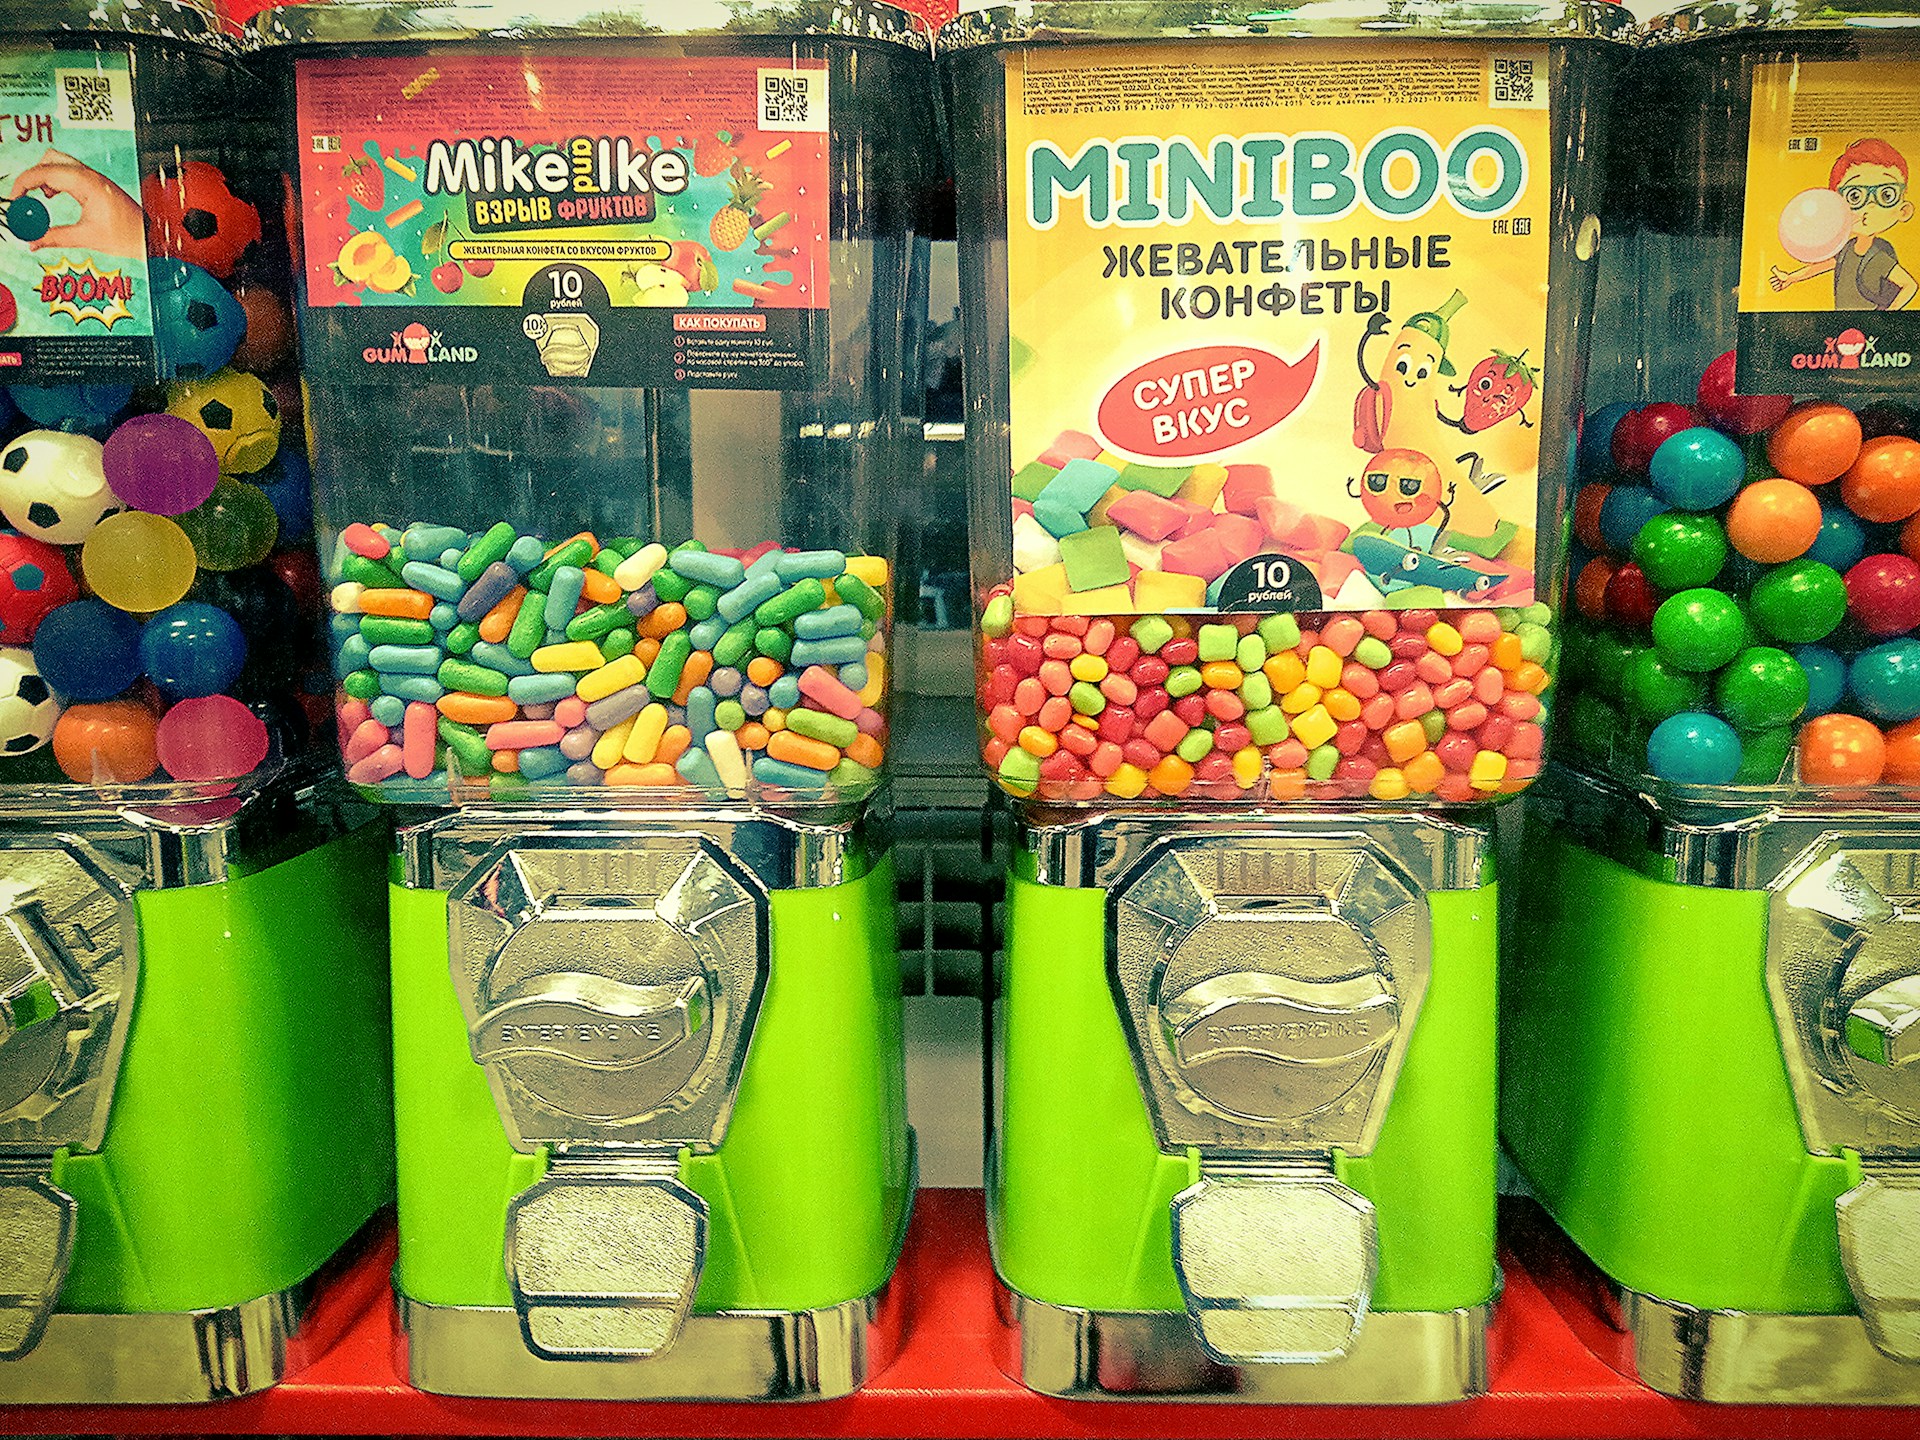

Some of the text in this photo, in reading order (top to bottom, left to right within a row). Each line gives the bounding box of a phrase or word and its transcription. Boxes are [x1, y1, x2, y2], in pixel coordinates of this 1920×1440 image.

[426, 138, 687, 193] Mike and Ike
[1030, 129, 1525, 225] MINIBOO
[475, 195, 649, 225] ВЗРЫВ ФРУКТОВ
[463, 245, 657, 255] ЖЕВАТЕЛЬНАЯ КОНФЕТА СО ВКУСОМ ФРУКТОВ
[1101, 233, 1452, 279] ЖЕВАТЕЛЬНЫЕ
[41, 274, 133, 302] BOOM!
[548, 270, 583, 299] 10
[550, 297, 583, 309] рублей
[1160, 279, 1391, 320] КОНФЕТЫ
[679, 317, 761, 329] КАК ПОКУПАТЬ
[362, 346, 479, 364] GUM LAND
[1791, 351, 1912, 369] GUM LAND
[1132, 358, 1257, 411] СУПЕР
[1151, 397, 1251, 445] ВКУС
[1252, 560, 1291, 589] 10
[1248, 589, 1292, 603] рублей
